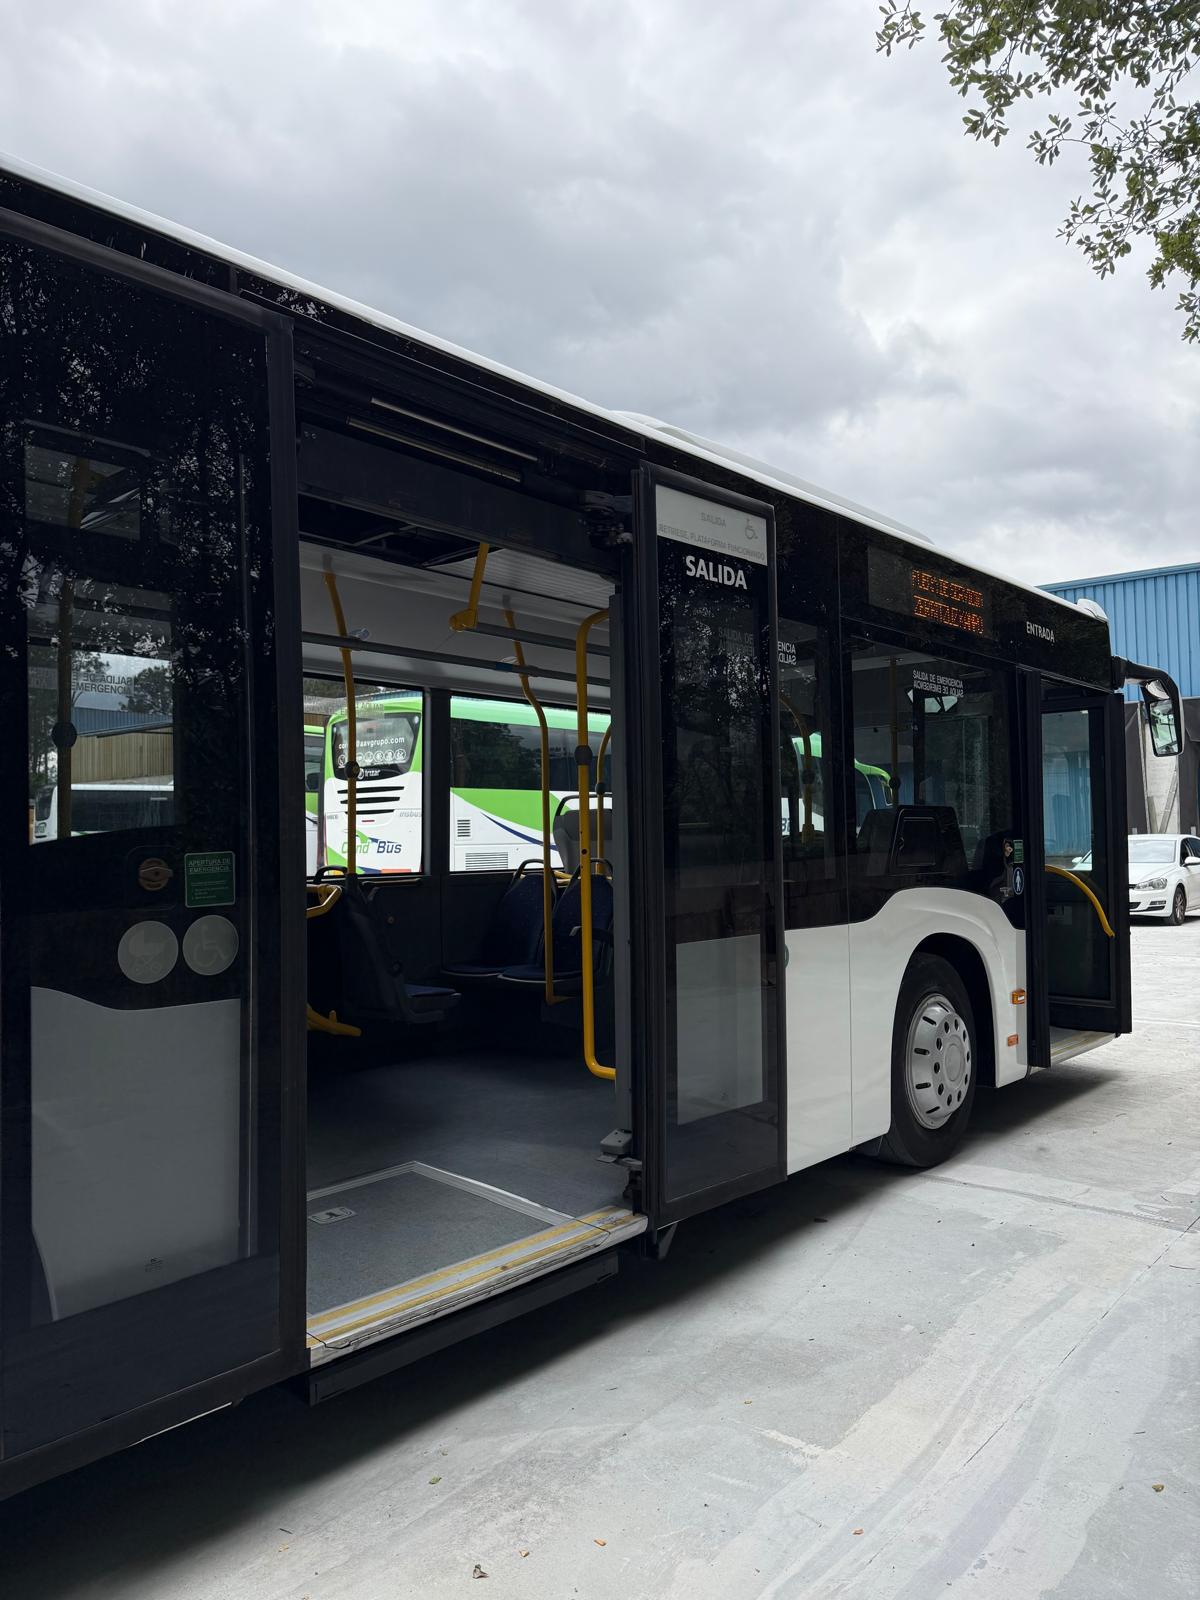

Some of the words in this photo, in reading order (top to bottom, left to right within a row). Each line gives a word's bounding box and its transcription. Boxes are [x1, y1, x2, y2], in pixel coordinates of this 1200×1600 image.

[685, 555, 748, 590] SALIDA
[1026, 621, 1055, 643] ENTRADA
[777, 641, 797, 654] ENCIA
[912, 669, 929, 681] SALIDA
[929, 673, 936, 683] DE
[936, 675, 963, 689] EMERGENCIA
[71, 681, 132, 696] EMERGENCIA
[376, 840, 403, 854] Bus
